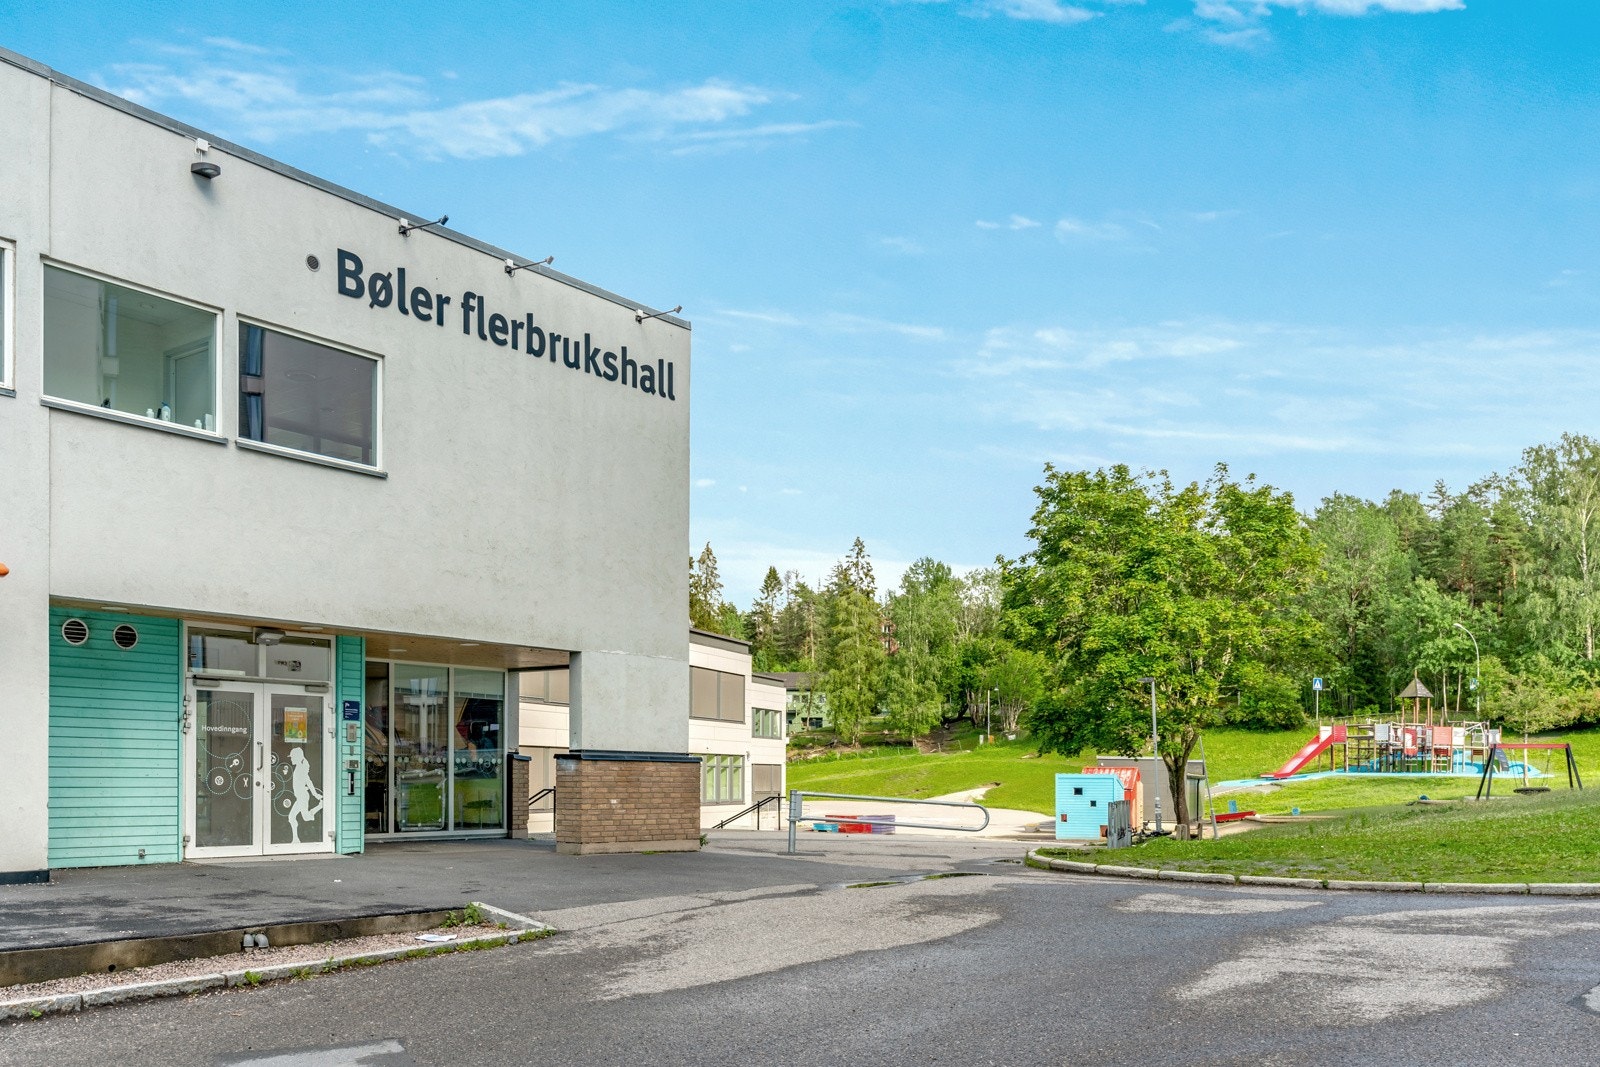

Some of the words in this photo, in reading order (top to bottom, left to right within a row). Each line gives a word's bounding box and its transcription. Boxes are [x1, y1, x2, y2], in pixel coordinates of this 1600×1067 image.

[337, 247, 452, 327] Bøler
[460, 291, 676, 402] flerbrukshall
[201, 724, 248, 735] Hovedinngang
